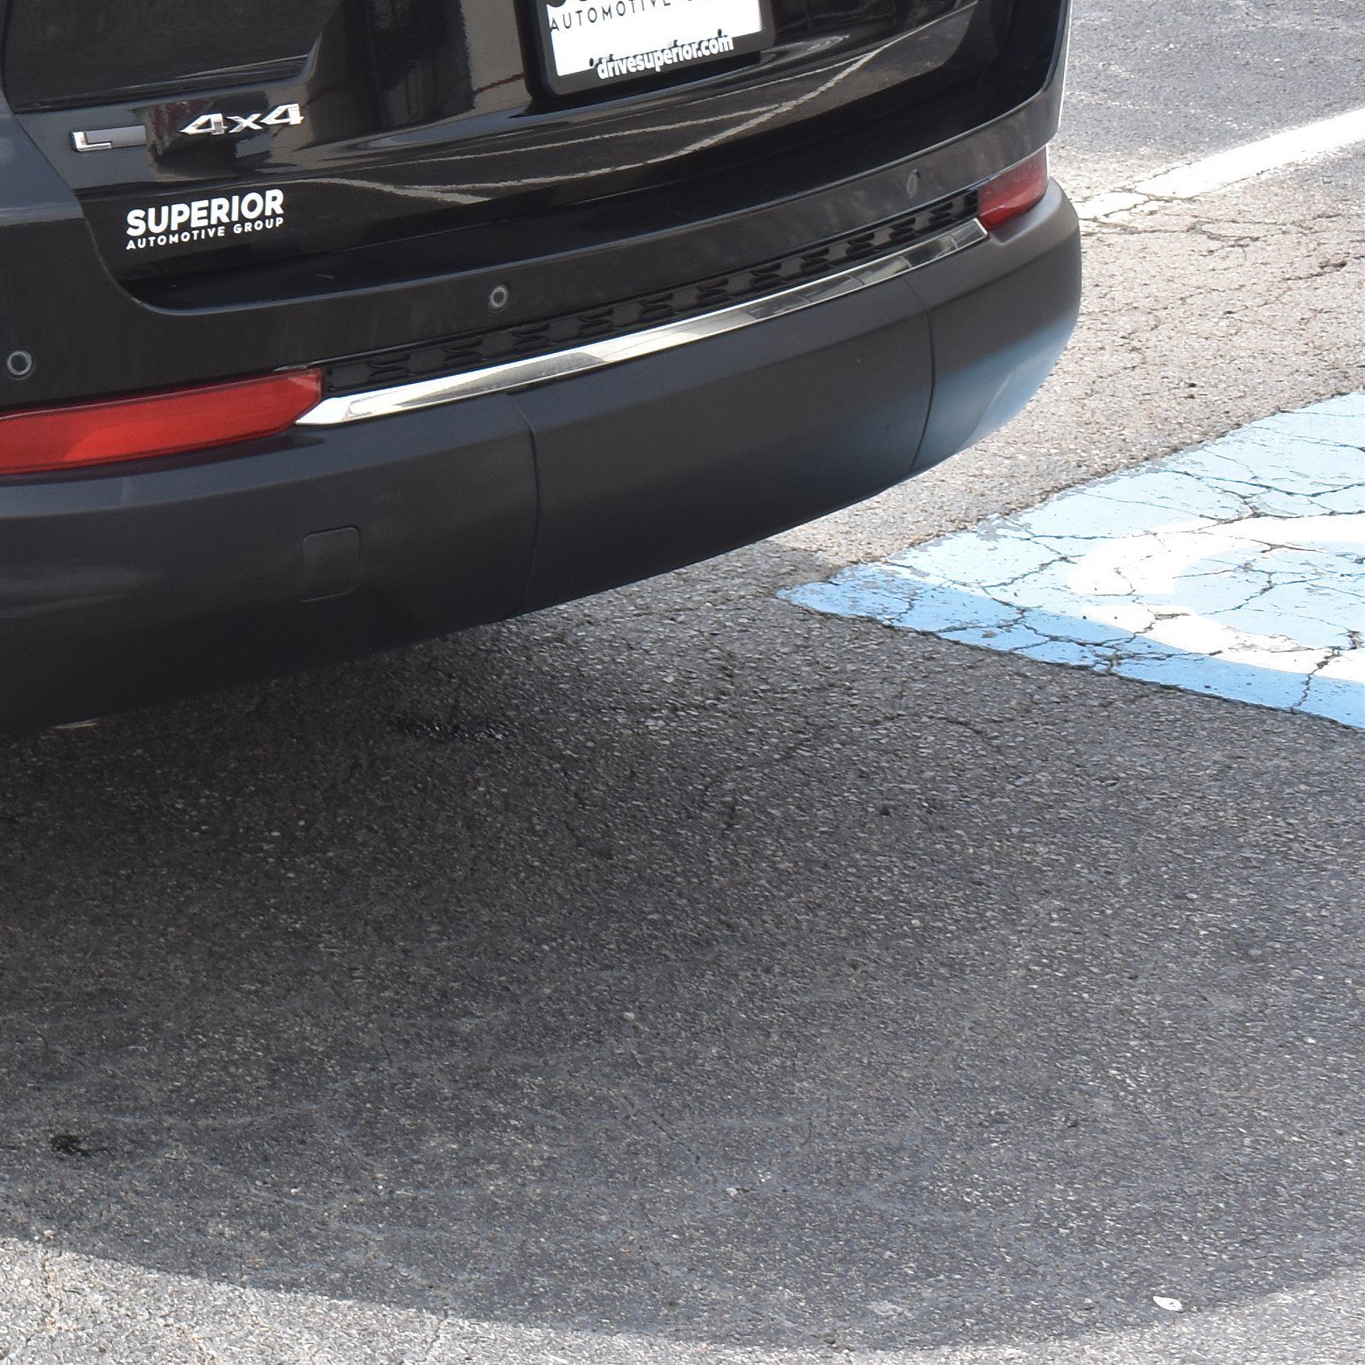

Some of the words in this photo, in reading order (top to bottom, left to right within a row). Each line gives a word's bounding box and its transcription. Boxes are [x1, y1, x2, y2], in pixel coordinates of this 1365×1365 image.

[596, 35, 735, 80] drivesuperior.com
[71, 130, 113, 153] L
[178, 102, 305, 136] 4x4
[125, 188, 285, 237] SUPERIOR
[125, 227, 226, 251] AUTOMOTIVE
[233, 216, 285, 235] GROUP
